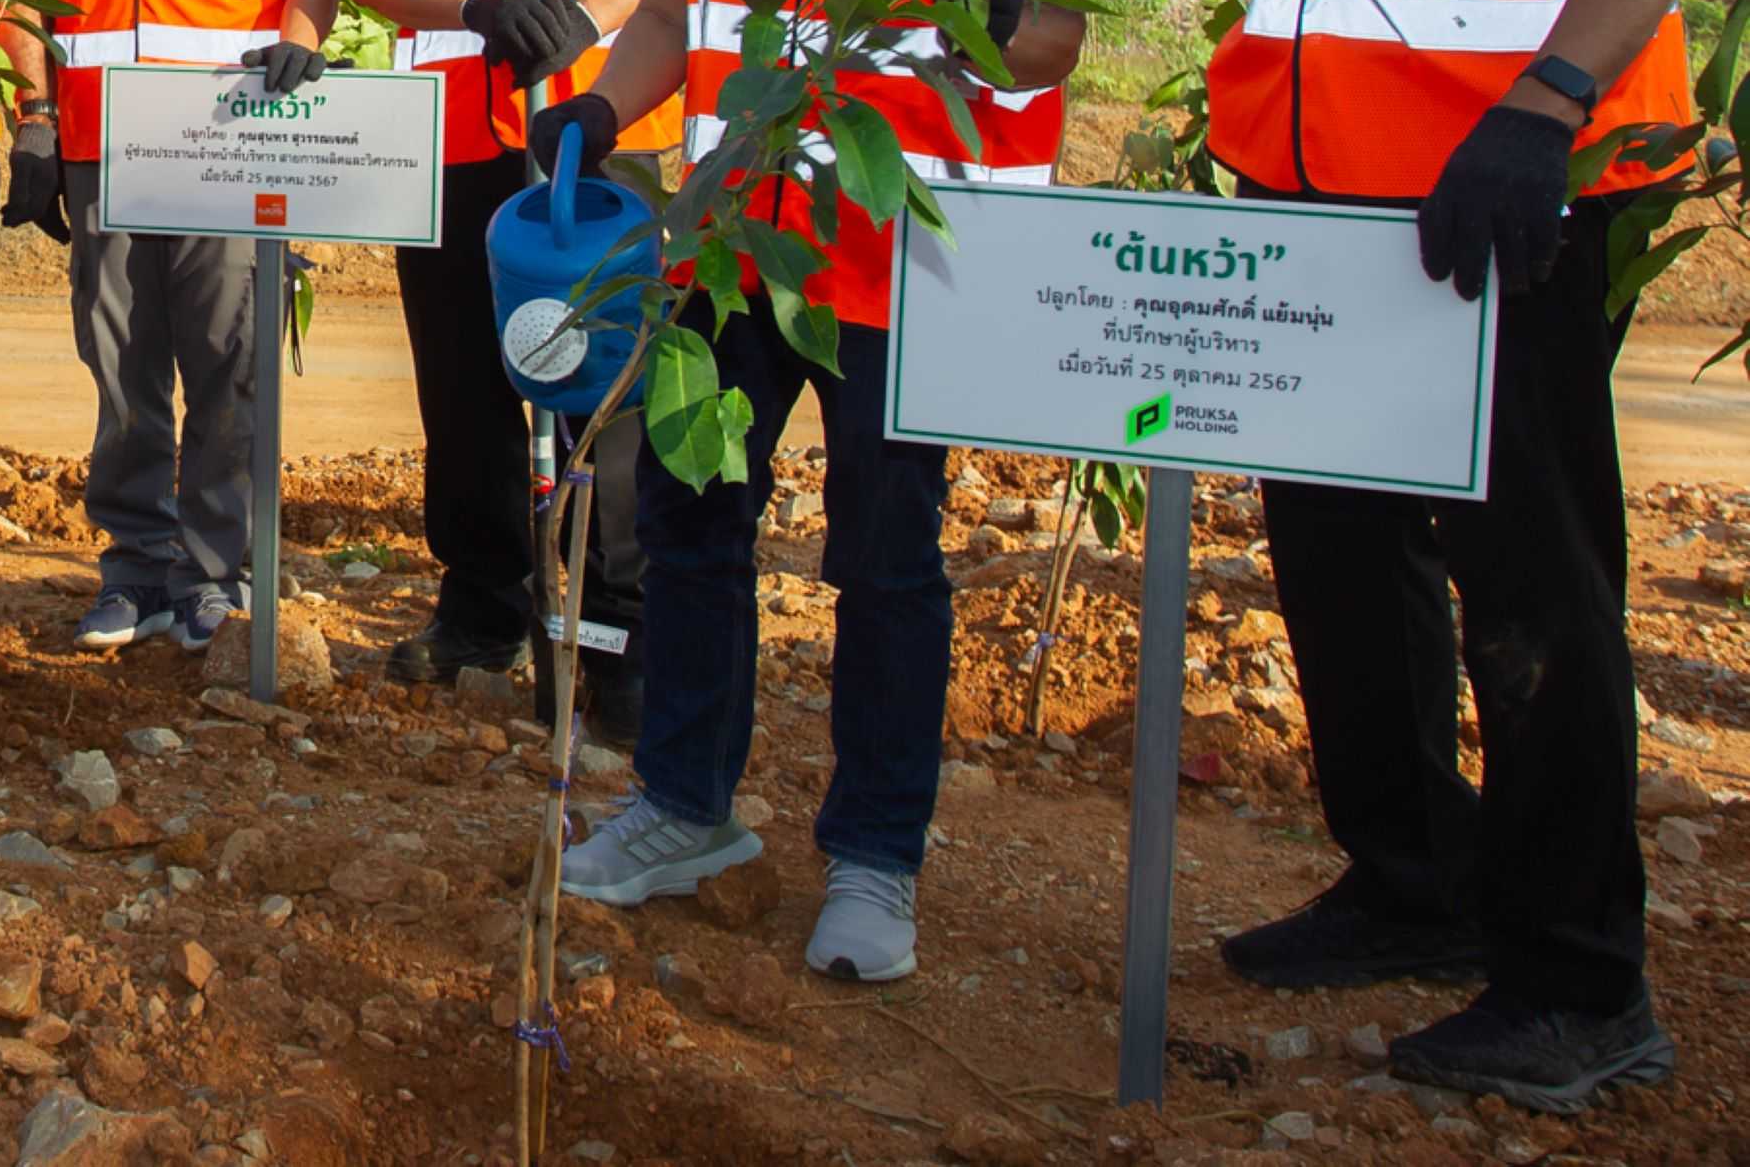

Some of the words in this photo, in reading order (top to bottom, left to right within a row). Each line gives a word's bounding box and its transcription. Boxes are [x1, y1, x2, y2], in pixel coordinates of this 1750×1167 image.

[216, 91, 326, 119] “ต้นหว้า”
[247, 173, 261, 183] 25
[308, 176, 339, 186] 2567
[1091, 231, 1286, 280] “ต้นหว้า”
[1036, 285, 1113, 312] ปลูกโดย
[1134, 294, 1257, 322] คุณอุดมศักดิ์
[1262, 301, 1334, 332] แย้มนุ่น
[1103, 316, 1260, 355] ที่ปรึกษาผู้บริหาร
[1058, 348, 1133, 378] เมื่อวันที่
[1140, 363, 1165, 380] 25
[1173, 367, 1241, 389] ตุลาคม
[1248, 372, 1302, 392] 2567
[1174, 405, 1239, 422] PRUKSA
[1174, 420, 1239, 435] HOLDING
